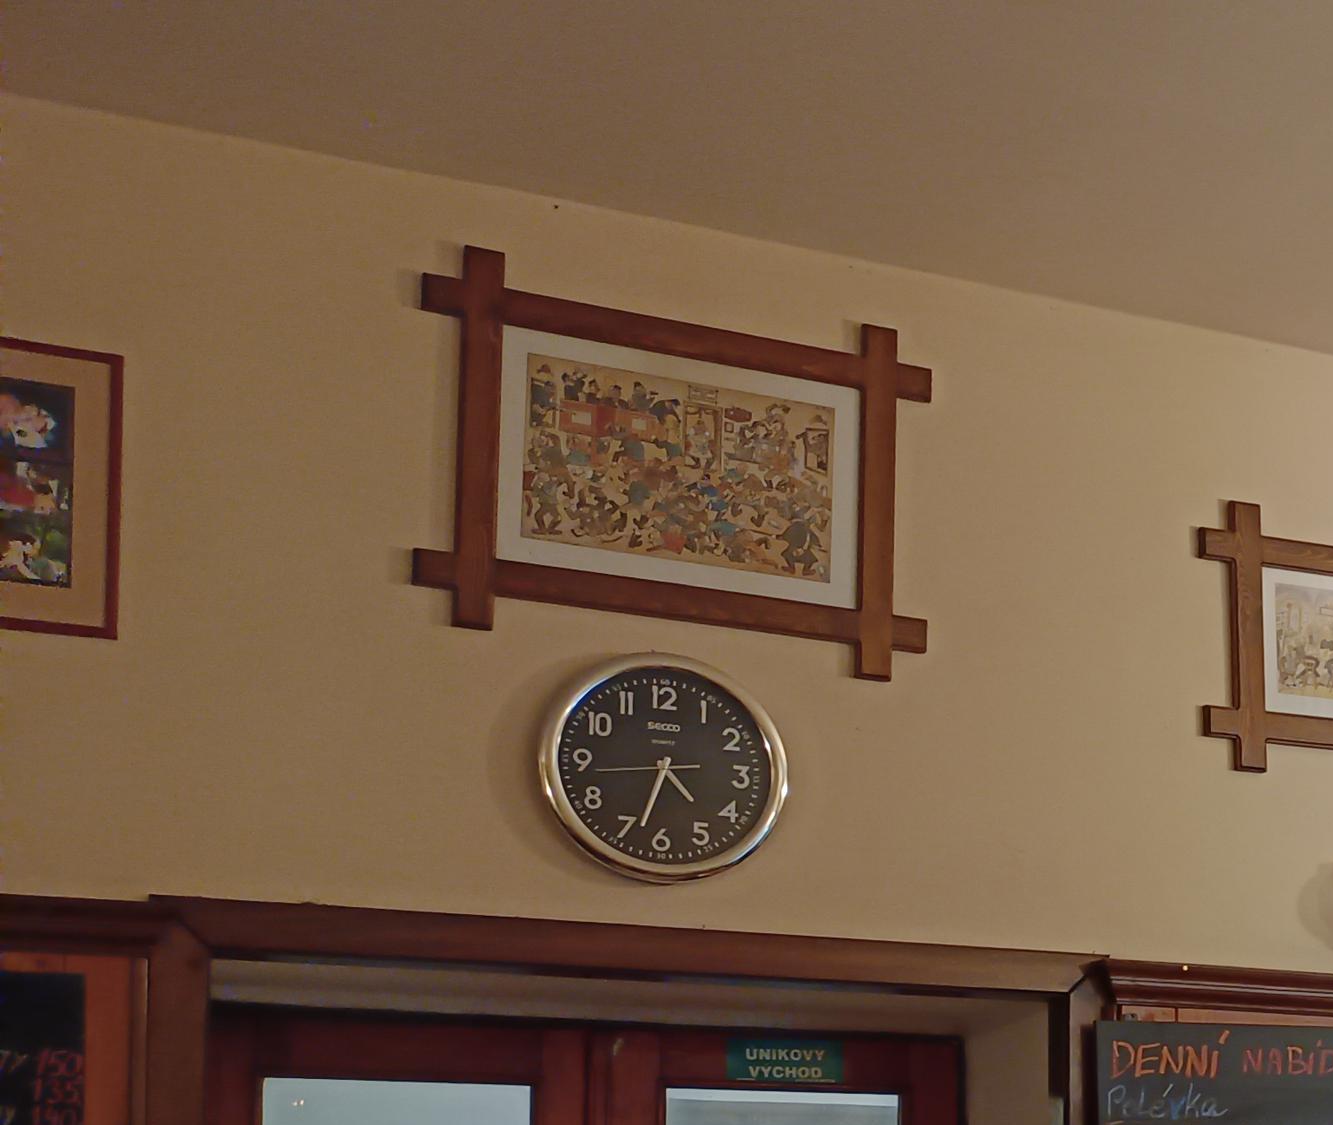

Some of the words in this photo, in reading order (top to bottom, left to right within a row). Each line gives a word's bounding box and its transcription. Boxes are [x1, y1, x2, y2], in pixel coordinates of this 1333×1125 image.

[619, 691, 634, 715] 11
[652, 685, 678, 711] 12
[588, 711, 612, 736] 10
[701, 700, 707, 724] 1
[647, 721, 680, 732] SECCO
[722, 727, 741, 751] 2
[573, 749, 592, 772] 9
[732, 765, 750, 789] 3
[584, 786, 602, 809] 8
[718, 800, 738, 823] 4
[617, 815, 637, 838] 7
[692, 822, 710, 846] 5
[652, 828, 671, 851] 6
[1111, 1029, 1230, 1079] DENNÍ
